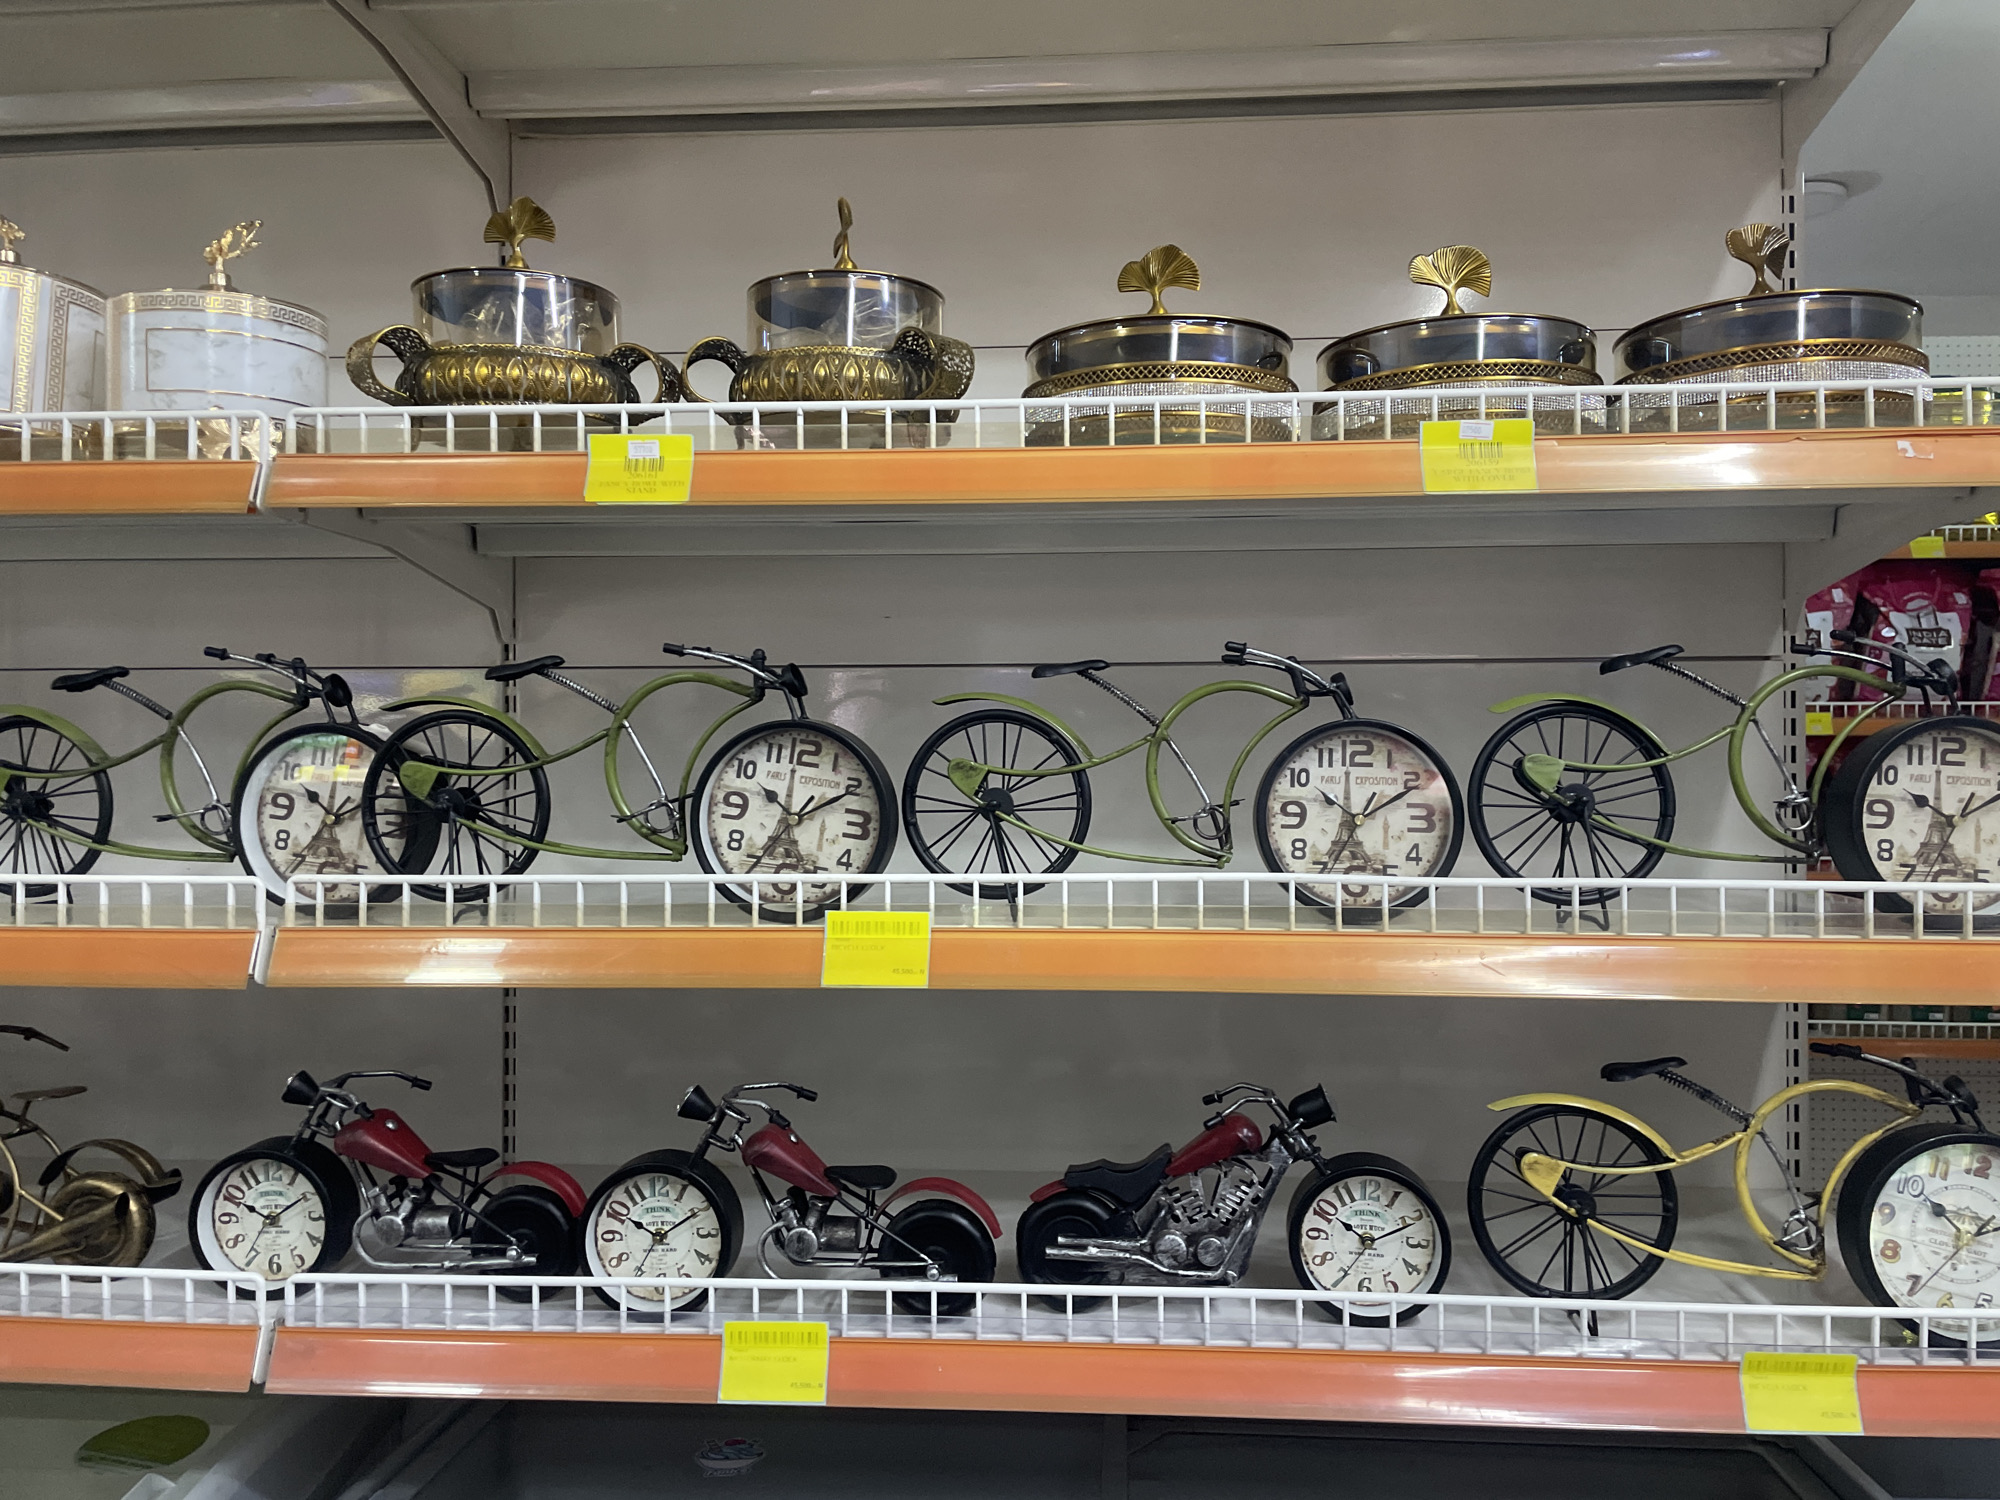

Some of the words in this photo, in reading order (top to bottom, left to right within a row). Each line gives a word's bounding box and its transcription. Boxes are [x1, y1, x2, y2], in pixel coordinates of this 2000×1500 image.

[1908, 630, 1949, 638] INDIA
[1911, 637, 1948, 645] GATE
[766, 742, 784, 764] 11
[788, 737, 823, 769] 12
[832, 752, 839, 772] 1
[1317, 747, 1334, 768] 11
[1341, 739, 1375, 768] 12
[1387, 749, 1393, 769] 1
[1907, 744, 1924, 766] 11
[1932, 736, 1967, 766] 12
[1980, 747, 1986, 769] 1
[736, 758, 757, 780] 10
[766, 770, 787, 782] PARIS
[799, 776, 841, 790] EXPOSITION
[1287, 767, 1310, 788] 10
[1876, 765, 1899, 786] 10
[845, 777, 863, 797] 2
[1320, 775, 1342, 785] PARIS
[1355, 776, 1398, 786] EXPOSITION
[1403, 771, 1421, 790] 2
[269, 792, 296, 821] 9
[721, 791, 749, 821] 9
[1280, 800, 1307, 829] 9
[1866, 799, 1895, 829] 9
[842, 808, 872, 841] 3
[1406, 803, 1436, 834] 3
[274, 829, 291, 850] 8
[727, 829, 744, 852] 8
[1291, 838, 1307, 860] 8
[1877, 838, 1894, 862] 8
[836, 848, 853, 871] 4
[1405, 843, 1423, 866] 4
[239, 1167, 262, 1191] 11
[263, 1161, 283, 1182] 12
[1928, 1155, 1950, 1181] 11
[623, 1181, 649, 1207] 11
[648, 1176, 670, 1198] 12
[674, 1183, 690, 1203] 1
[1332, 1181, 1358, 1208] 11
[1358, 1179, 1381, 1202] 12
[1897, 1171, 1924, 1198] 10
[223, 1184, 246, 1209] 10
[1384, 1190, 1403, 1210] 1
[218, 1212, 239, 1225] 9
[308, 1210, 325, 1223] 3
[606, 1200, 631, 1226] 10
[645, 1206, 672, 1214] THINK
[1313, 1198, 1339, 1225] 10
[1354, 1209, 1381, 1218] THINK
[1399, 1208, 1423, 1226] 2
[1878, 1202, 1896, 1226] 9
[225, 1233, 246, 1249] 8
[306, 1231, 323, 1248] 4
[601, 1229, 624, 1243] 9
[696, 1226, 719, 1240] 3
[1305, 1227, 1329, 1241] 9
[1405, 1236, 1431, 1250] 3
[244, 1246, 261, 1268] 7
[290, 1246, 306, 1269] 5
[608, 1252, 630, 1268] 8
[693, 1248, 714, 1267] 4
[1312, 1251, 1334, 1267] 8
[1880, 1239, 1902, 1263] 8
[268, 1253, 282, 1275] 6
[1402, 1257, 1422, 1276] 4
[1331, 1266, 1351, 1289] 7
[1382, 1271, 1399, 1293] 5
[1906, 1273, 1923, 1297] 7
